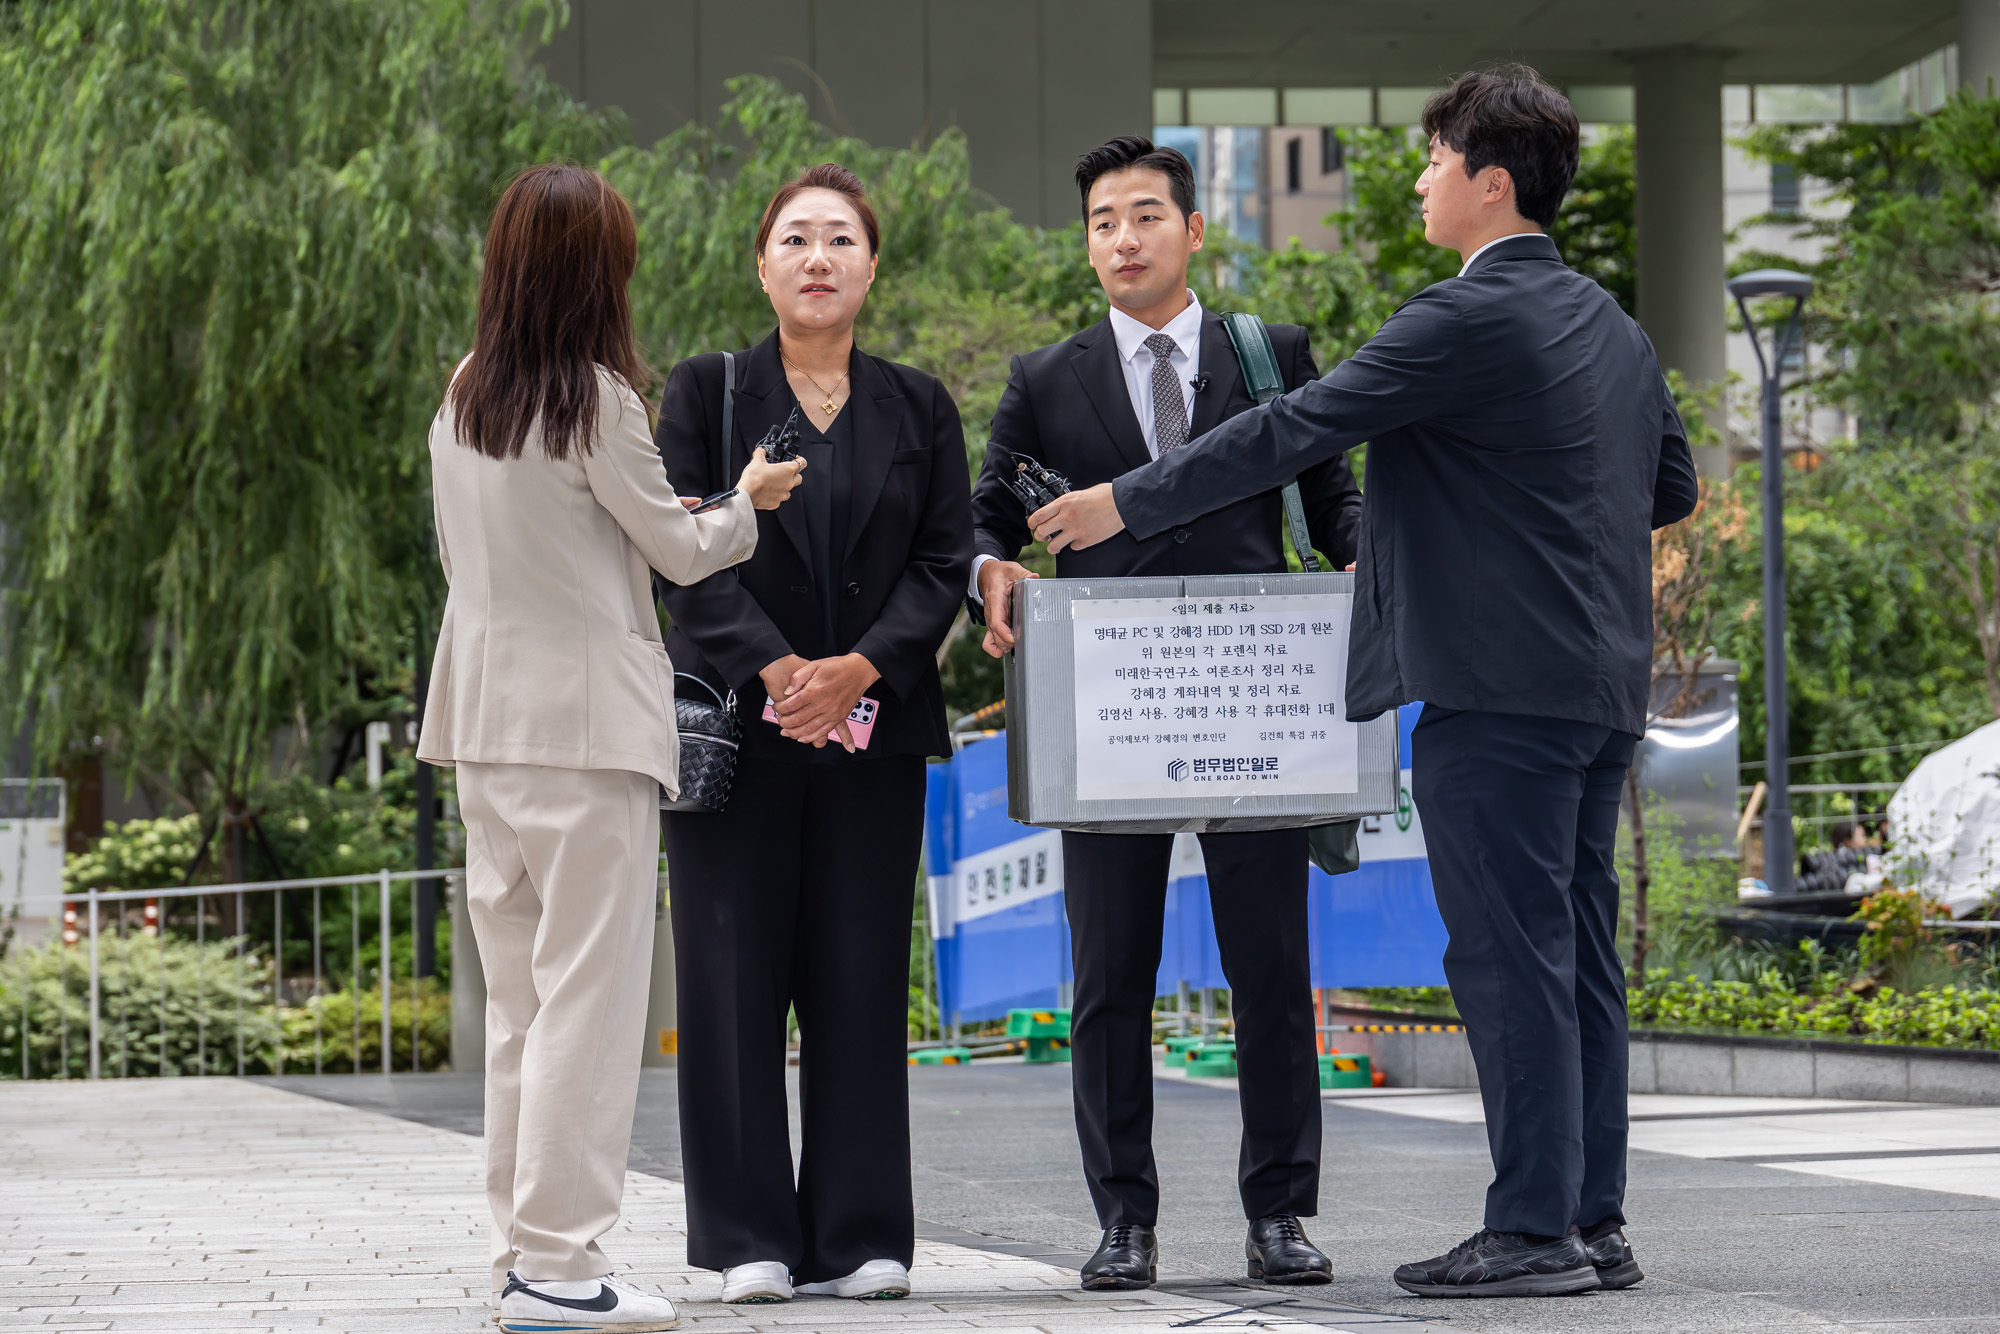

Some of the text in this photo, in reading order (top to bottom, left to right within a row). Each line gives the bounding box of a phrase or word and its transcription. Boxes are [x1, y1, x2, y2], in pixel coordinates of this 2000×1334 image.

[1171, 603, 1255, 615] <임의 제출 자료>
[1094, 623, 1333, 640] 명태균 PC 및 강혜경 HDD 1개 SSD 2개 원본
[1142, 644, 1288, 659] 위 원본의 각 포렌식 자료
[1115, 663, 1316, 680] 미래한국연구소 여론조사 정리 자료
[1131, 684, 1301, 700] 강혜경 계좌내역 및 정리 자료
[1097, 708, 1132, 721] 김영선
[1174, 706, 1208, 719] 강혜경
[1216, 705, 1239, 718] 사용
[1245, 705, 1257, 718] 각
[1263, 703, 1311, 717] 휴대전화
[1318, 703, 1335, 715] 1대
[1107, 732, 1226, 744] 공익제보자 강혜경의 변호인단
[1259, 730, 1327, 741] 김건희 특검 귀중
[1194, 757, 1278, 773] 법무법인일로
